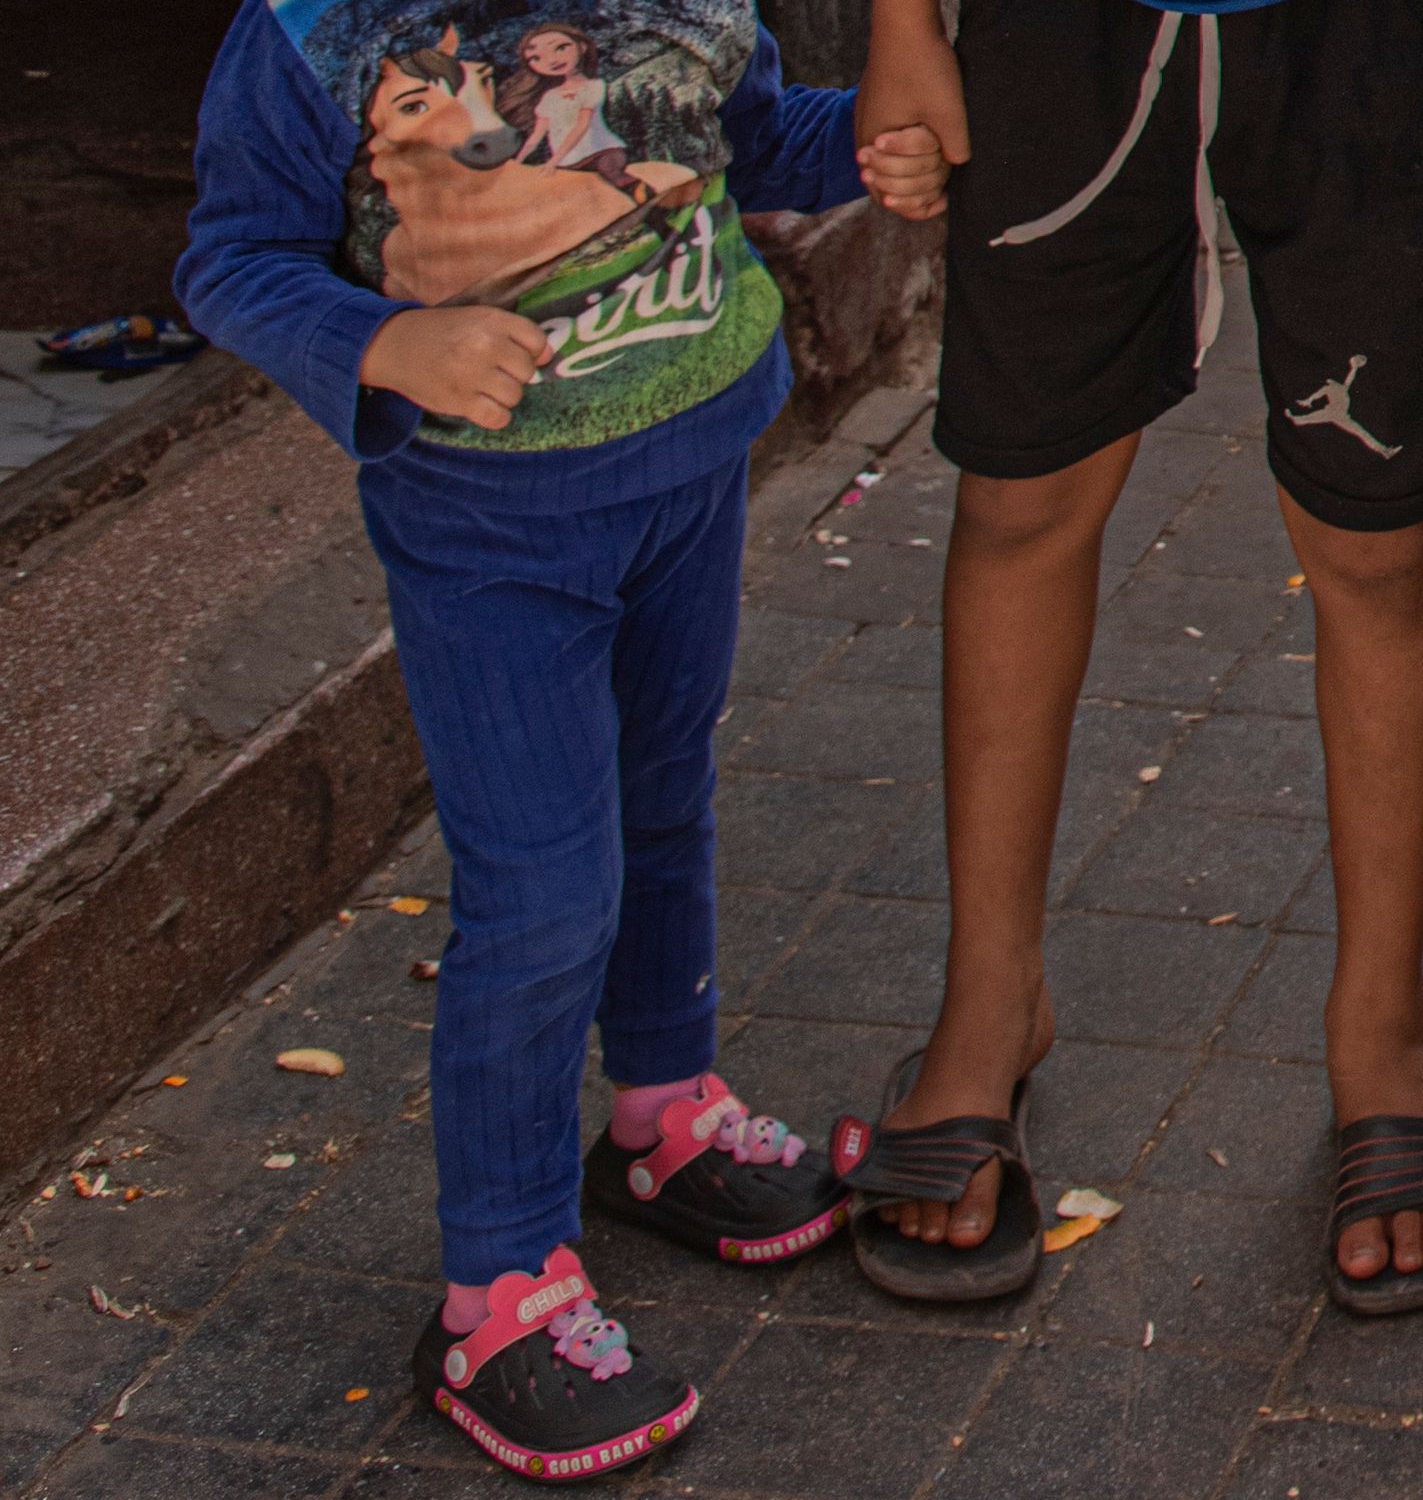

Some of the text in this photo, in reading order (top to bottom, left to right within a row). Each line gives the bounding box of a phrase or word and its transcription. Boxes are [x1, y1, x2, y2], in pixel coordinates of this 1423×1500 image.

[526, 206, 723, 384] pirit
[517, 1274, 585, 1324] CHILD
[548, 1435, 645, 1475] GOOD BABY
